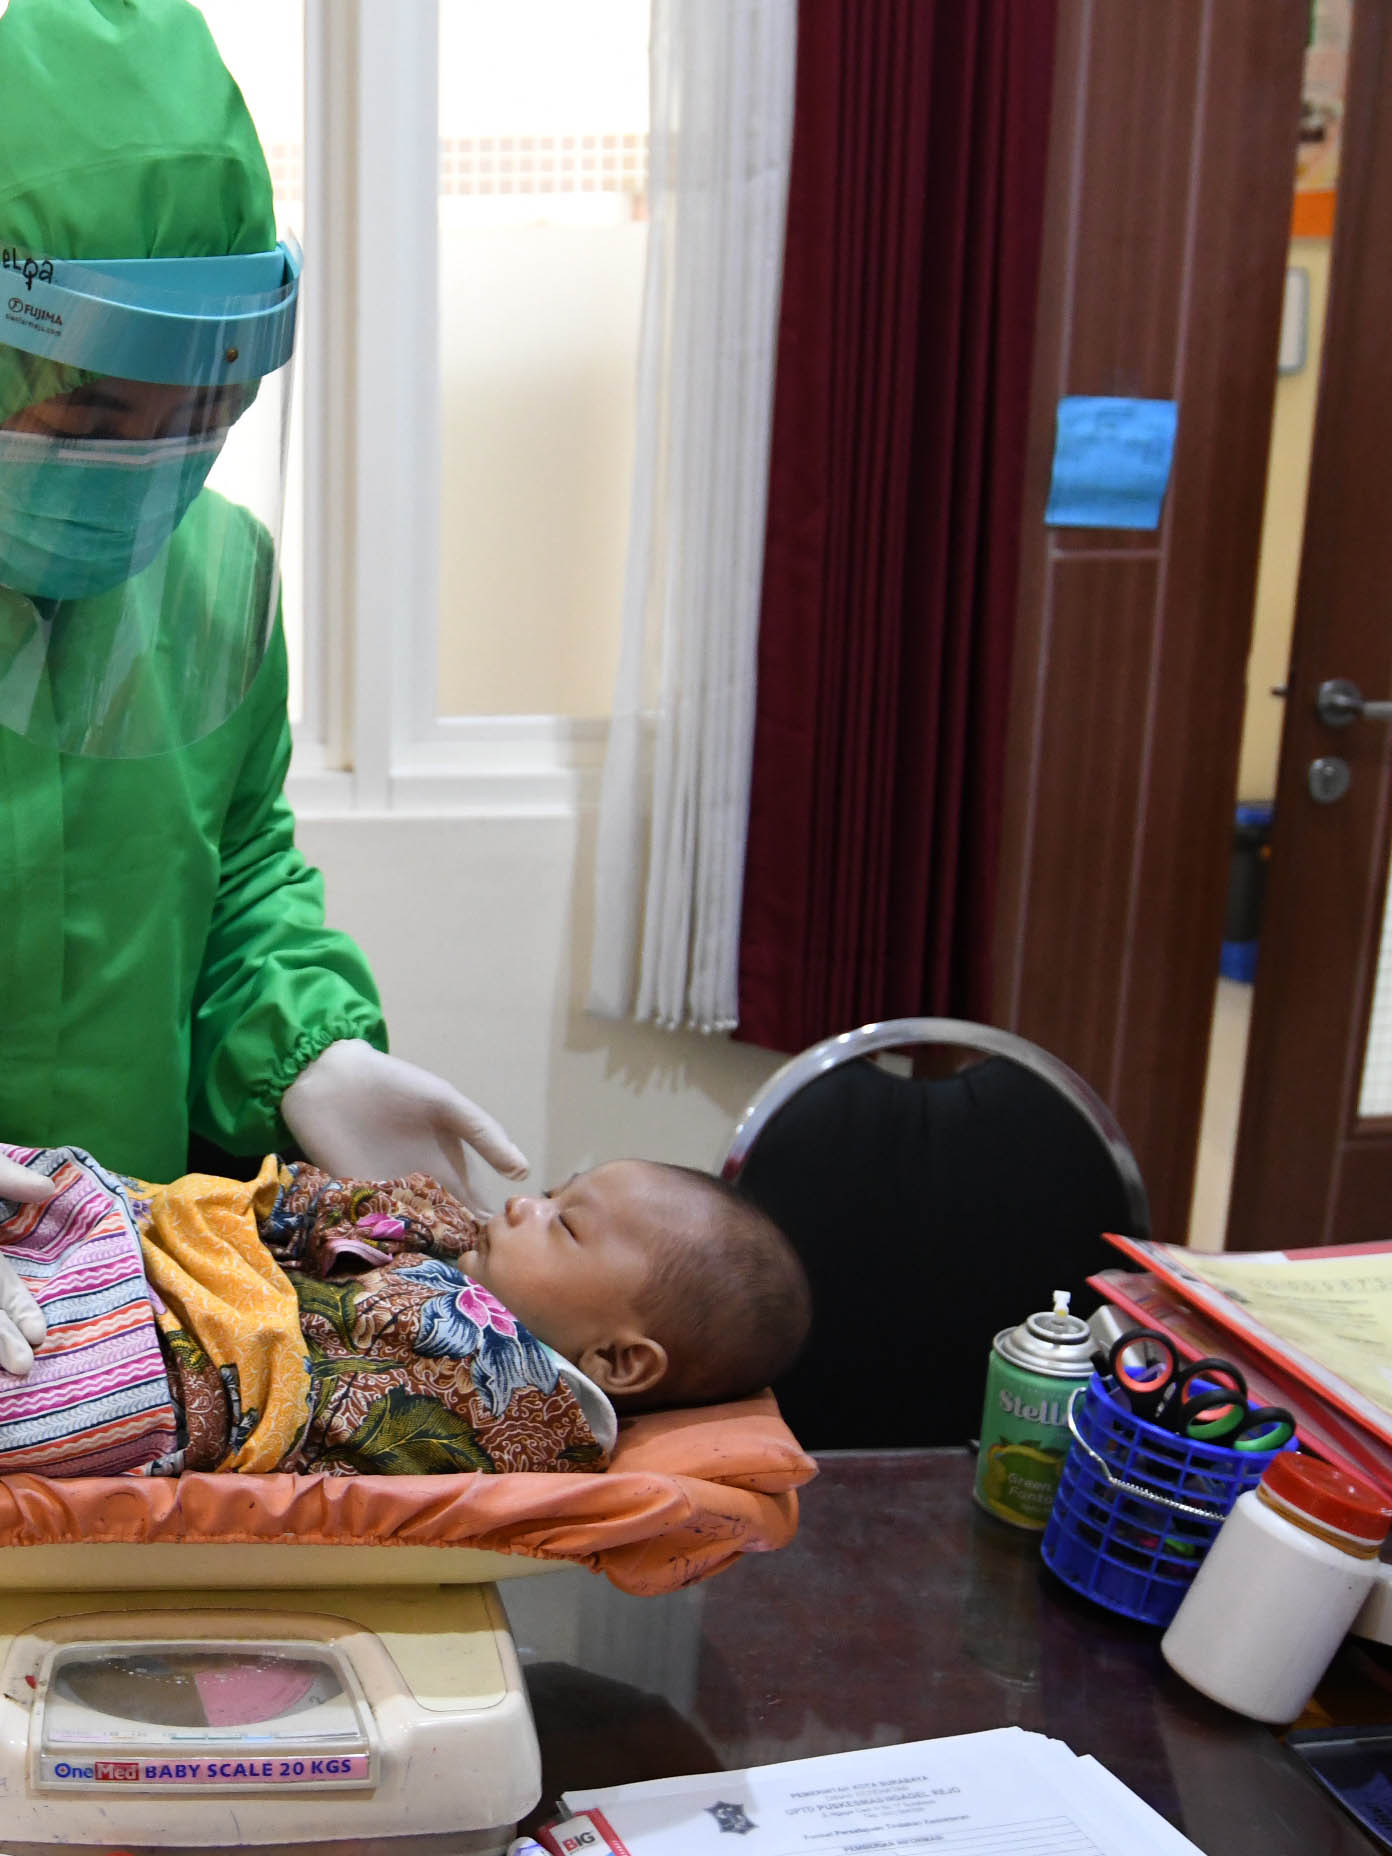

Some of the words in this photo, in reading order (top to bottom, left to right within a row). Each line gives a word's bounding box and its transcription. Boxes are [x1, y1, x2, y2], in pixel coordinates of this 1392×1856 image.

[24, 303, 63, 326] FUJIMA
[54, 1761, 139, 1781] OneMed
[145, 1764, 200, 1780] BABY
[207, 1762, 272, 1778] SCALE
[279, 1761, 304, 1777] 20
[311, 1759, 351, 1775] KGS
[561, 1831, 596, 1852] BIG
